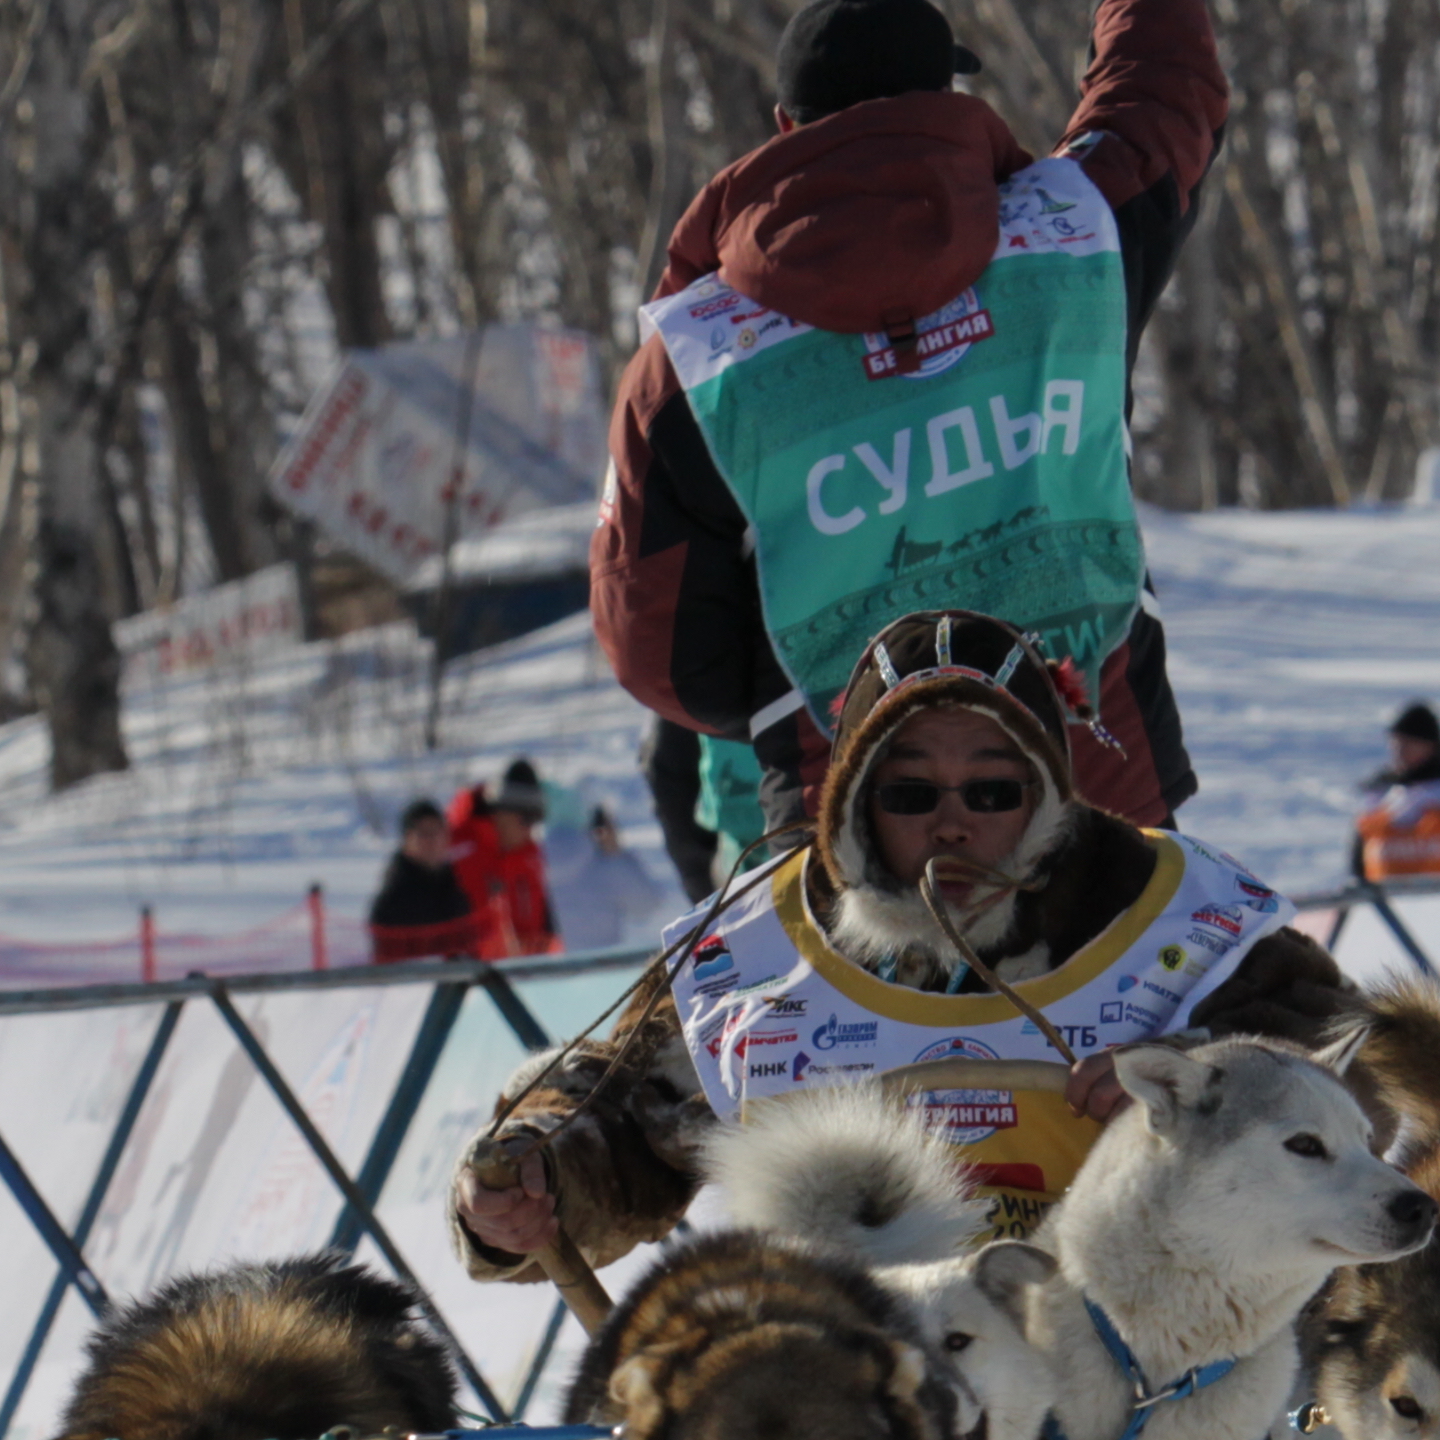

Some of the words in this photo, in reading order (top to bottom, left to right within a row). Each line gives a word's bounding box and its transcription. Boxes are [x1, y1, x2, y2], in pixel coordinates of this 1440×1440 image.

[868, 312, 990, 375] БЕИНГИЯ
[804, 378, 1086, 537] СУДЬЯ
[749, 1060, 788, 1078] ННК
[921, 1105, 1014, 1124] ЕРИНГИЯ
